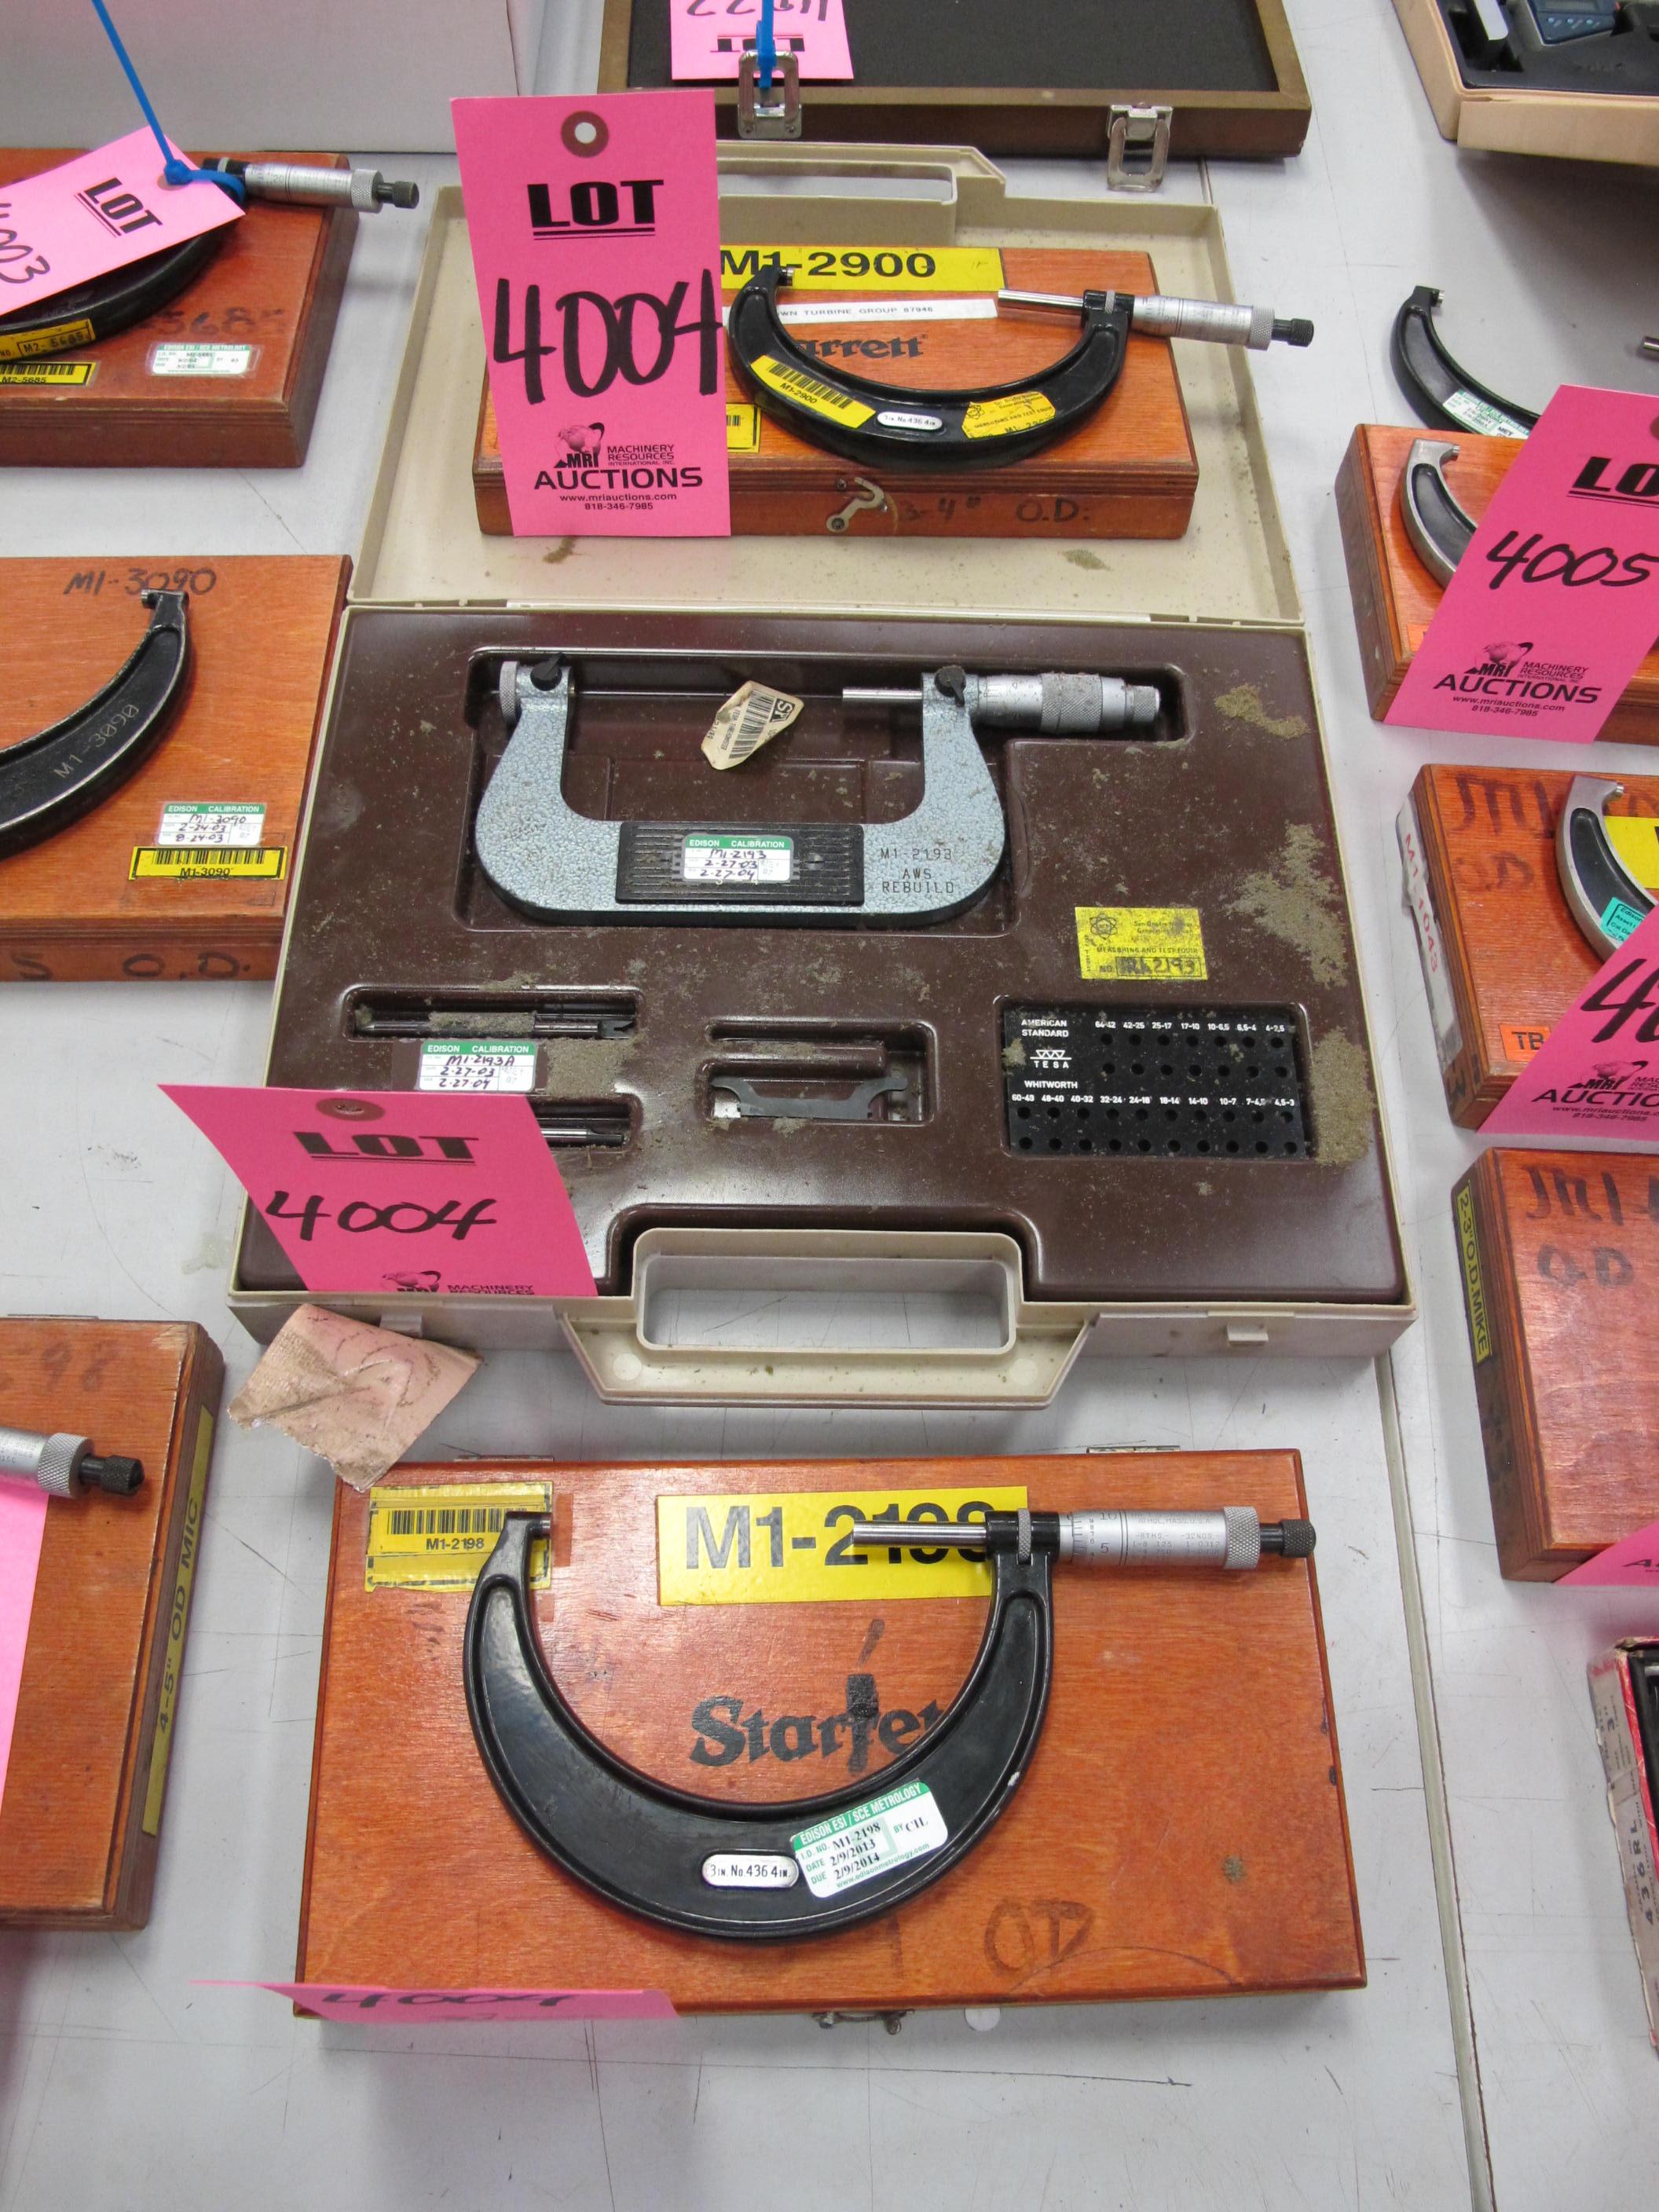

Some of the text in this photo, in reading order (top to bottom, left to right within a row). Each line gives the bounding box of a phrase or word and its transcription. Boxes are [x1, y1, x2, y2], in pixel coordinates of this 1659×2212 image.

[84, 178, 163, 234] LOT
[527, 179, 664, 227] LOT
[493, 269, 723, 405] 4004
[780, 382, 818, 405] M1-2900
[606, 444, 675, 453] MACHINERY
[607, 452, 675, 461] RESOURCES
[567, 452, 599, 468] MRI
[534, 467, 704, 490] AUCTIONS
[559, 492, 677, 502] www.mriauctions.com
[584, 501, 654, 511] 818-346-7985
[1520, 668, 1584, 679] RESOURCES
[1522, 661, 1590, 673] MACHINERY
[1433, 673, 1602, 704] AUCTIONS
[1452, 695, 1566, 712] www.mriauctions.com
[1471, 705, 1538, 716] 818-346-7985
[880, 848, 953, 861] M1-2193
[180, 867, 231, 878] M1-3090
[903, 867, 932, 880] AWS
[881, 881, 955, 894] REBUILD
[472, 1045, 529, 1053] CALIBRATION
[1024, 1080, 1079, 1089] WHITWORTH
[293, 1131, 479, 1159] LOT
[266, 1191, 496, 1241] 4004
[426, 1536, 485, 1551] M1-2198
[172, 1585, 187, 1642] OD
[181, 1497, 198, 1569] MIC
[800, 1822, 833, 1846] EDISON
[832, 1816, 848, 1832] ESI
[852, 1807, 871, 1823] SCE
[872, 1782, 923, 1815] METROLOGY
[832, 1822, 881, 1850] M1-2198
[806, 1838, 877, 1873] DATE 2/9/2013
[746, 1864, 768, 1878] 436
[810, 1851, 881, 1885] DUE 2/9/2014
[836, 1842, 931, 1889] www.edisonmetrology.com
